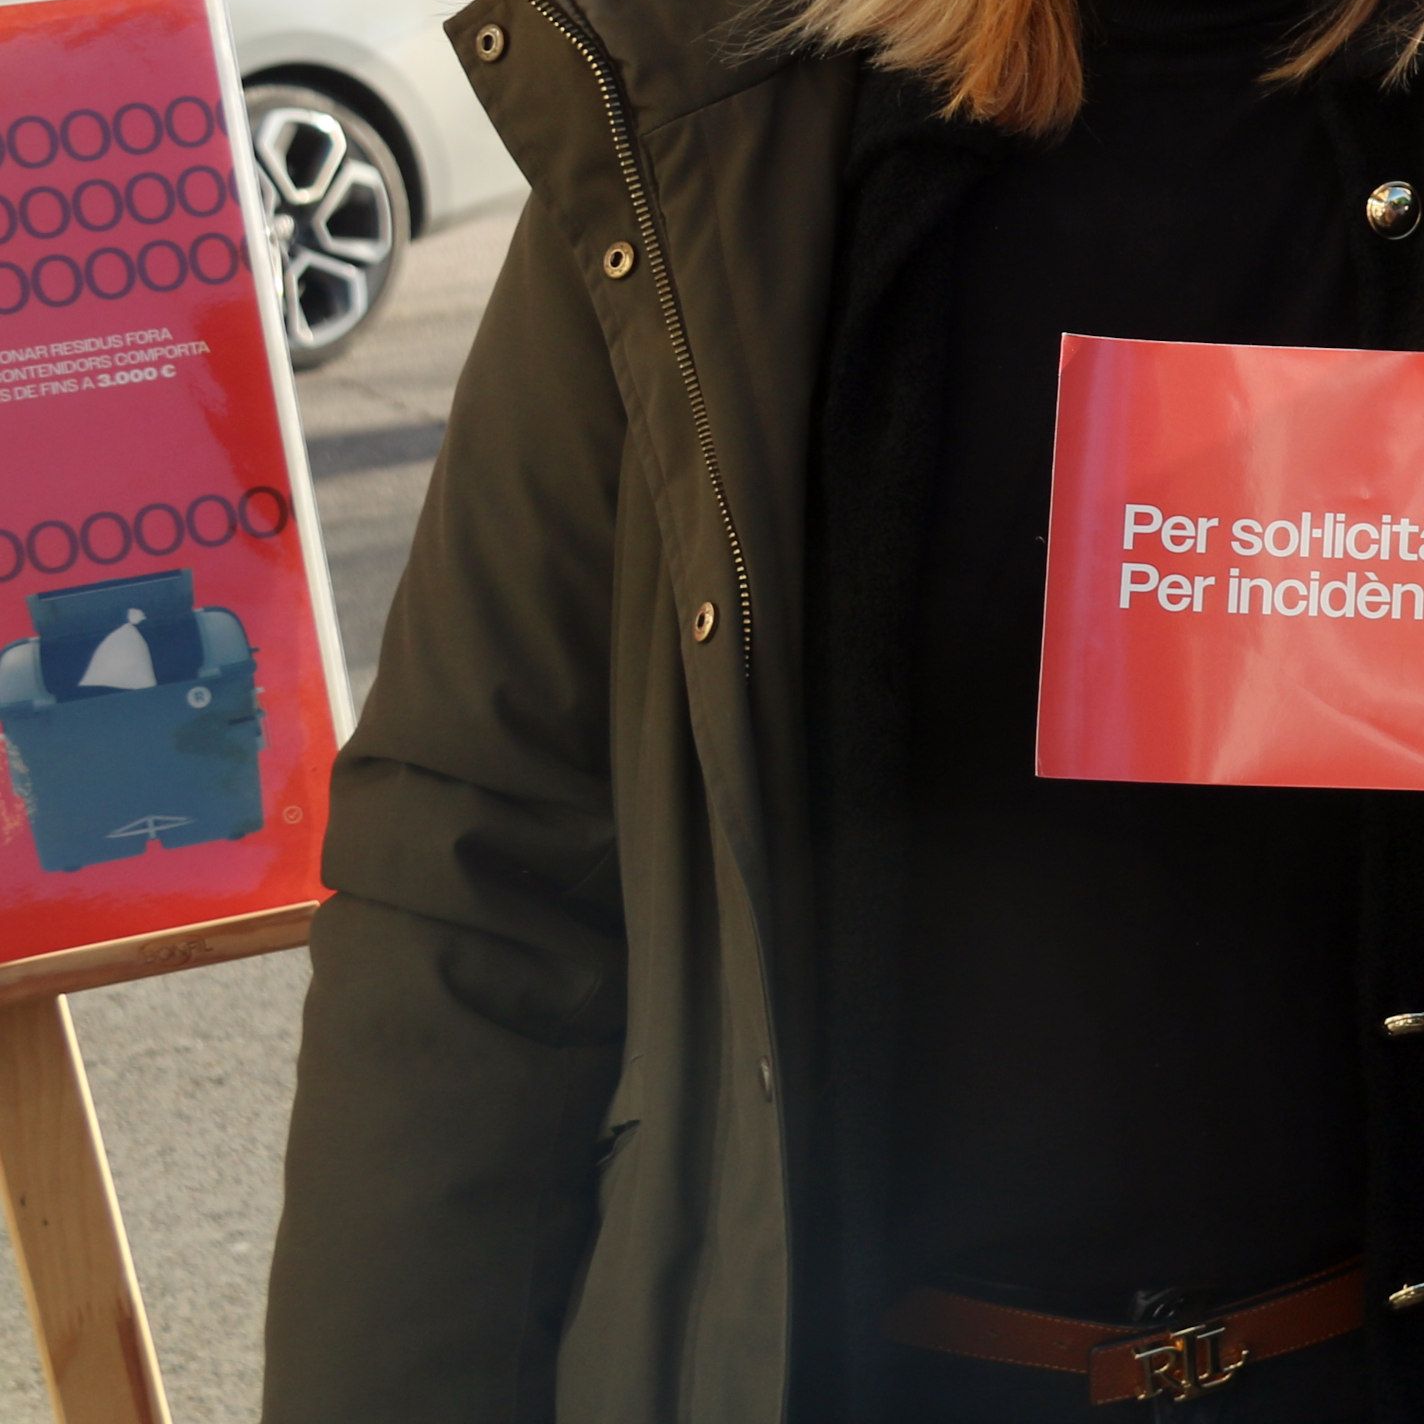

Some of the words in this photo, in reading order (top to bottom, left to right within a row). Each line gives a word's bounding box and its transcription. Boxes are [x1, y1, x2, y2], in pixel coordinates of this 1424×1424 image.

[0, 355, 112, 383] ONTENIDORS
[114, 340, 211, 366] COMPORTA
[51, 334, 123, 357] RESIDUS
[126, 327, 173, 347] FORA
[14, 384, 39, 401] DE
[40, 378, 79, 397] FINS
[82, 376, 96, 391] A
[97, 367, 158, 388] 3.000
[161, 364, 177, 379] €
[1123, 503, 1219, 554] Per
[1118, 561, 1216, 613] Per
